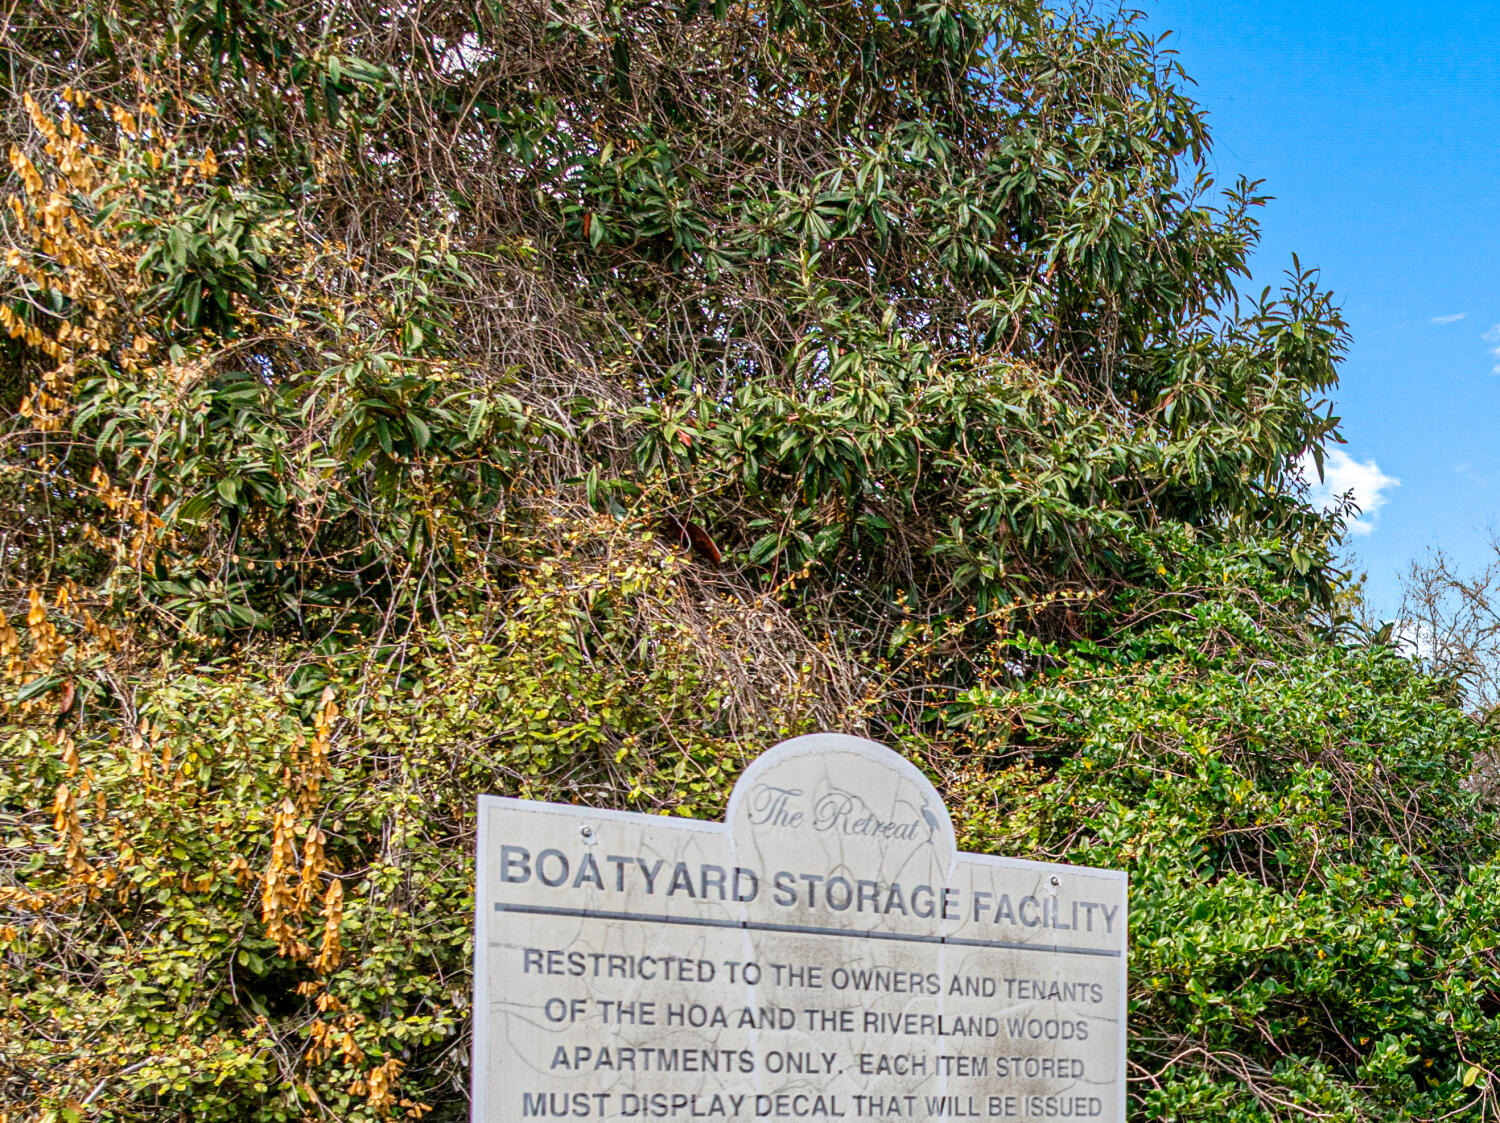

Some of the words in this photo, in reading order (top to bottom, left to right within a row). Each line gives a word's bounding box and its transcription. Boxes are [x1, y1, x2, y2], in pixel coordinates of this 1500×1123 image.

[748, 784, 803, 828] The
[813, 792, 920, 840] Retreat
[500, 844, 759, 903] BOATYARD
[774, 871, 961, 920] STORAGE
[973, 891, 1120, 934] FACILITY
[523, 950, 715, 982] RESTRICTED
[724, 961, 761, 985] TO
[770, 963, 822, 988] THE
[831, 966, 941, 995] OWNERS
[949, 975, 996, 998] AND
[1003, 978, 1103, 1003] TENANTS
[544, 997, 587, 1023] OF
[596, 1000, 656, 1026] THE
[667, 1003, 728, 1029] HOA
[738, 1006, 796, 1031] AND
[804, 1009, 854, 1033] THE
[863, 1011, 999, 1038] RIVERLAND
[1006, 1018, 1089, 1041] WOODS
[550, 1045, 755, 1074] APARTMENTS
[765, 1050, 843, 1075] ONLY.
[860, 1053, 926, 1076] EACH
[935, 1055, 988, 1077] ITEM
[996, 1057, 1085, 1079] STORED
[522, 1092, 610, 1118] MUST
[621, 1093, 745, 1117] DISPLAY
[755, 1094, 844, 1117] DECAL
[852, 1095, 917, 1117] THAT
[925, 1096, 980, 1117] WILL
[988, 1097, 1017, 1117] BE
[1025, 1096, 1103, 1118] ISSUED
